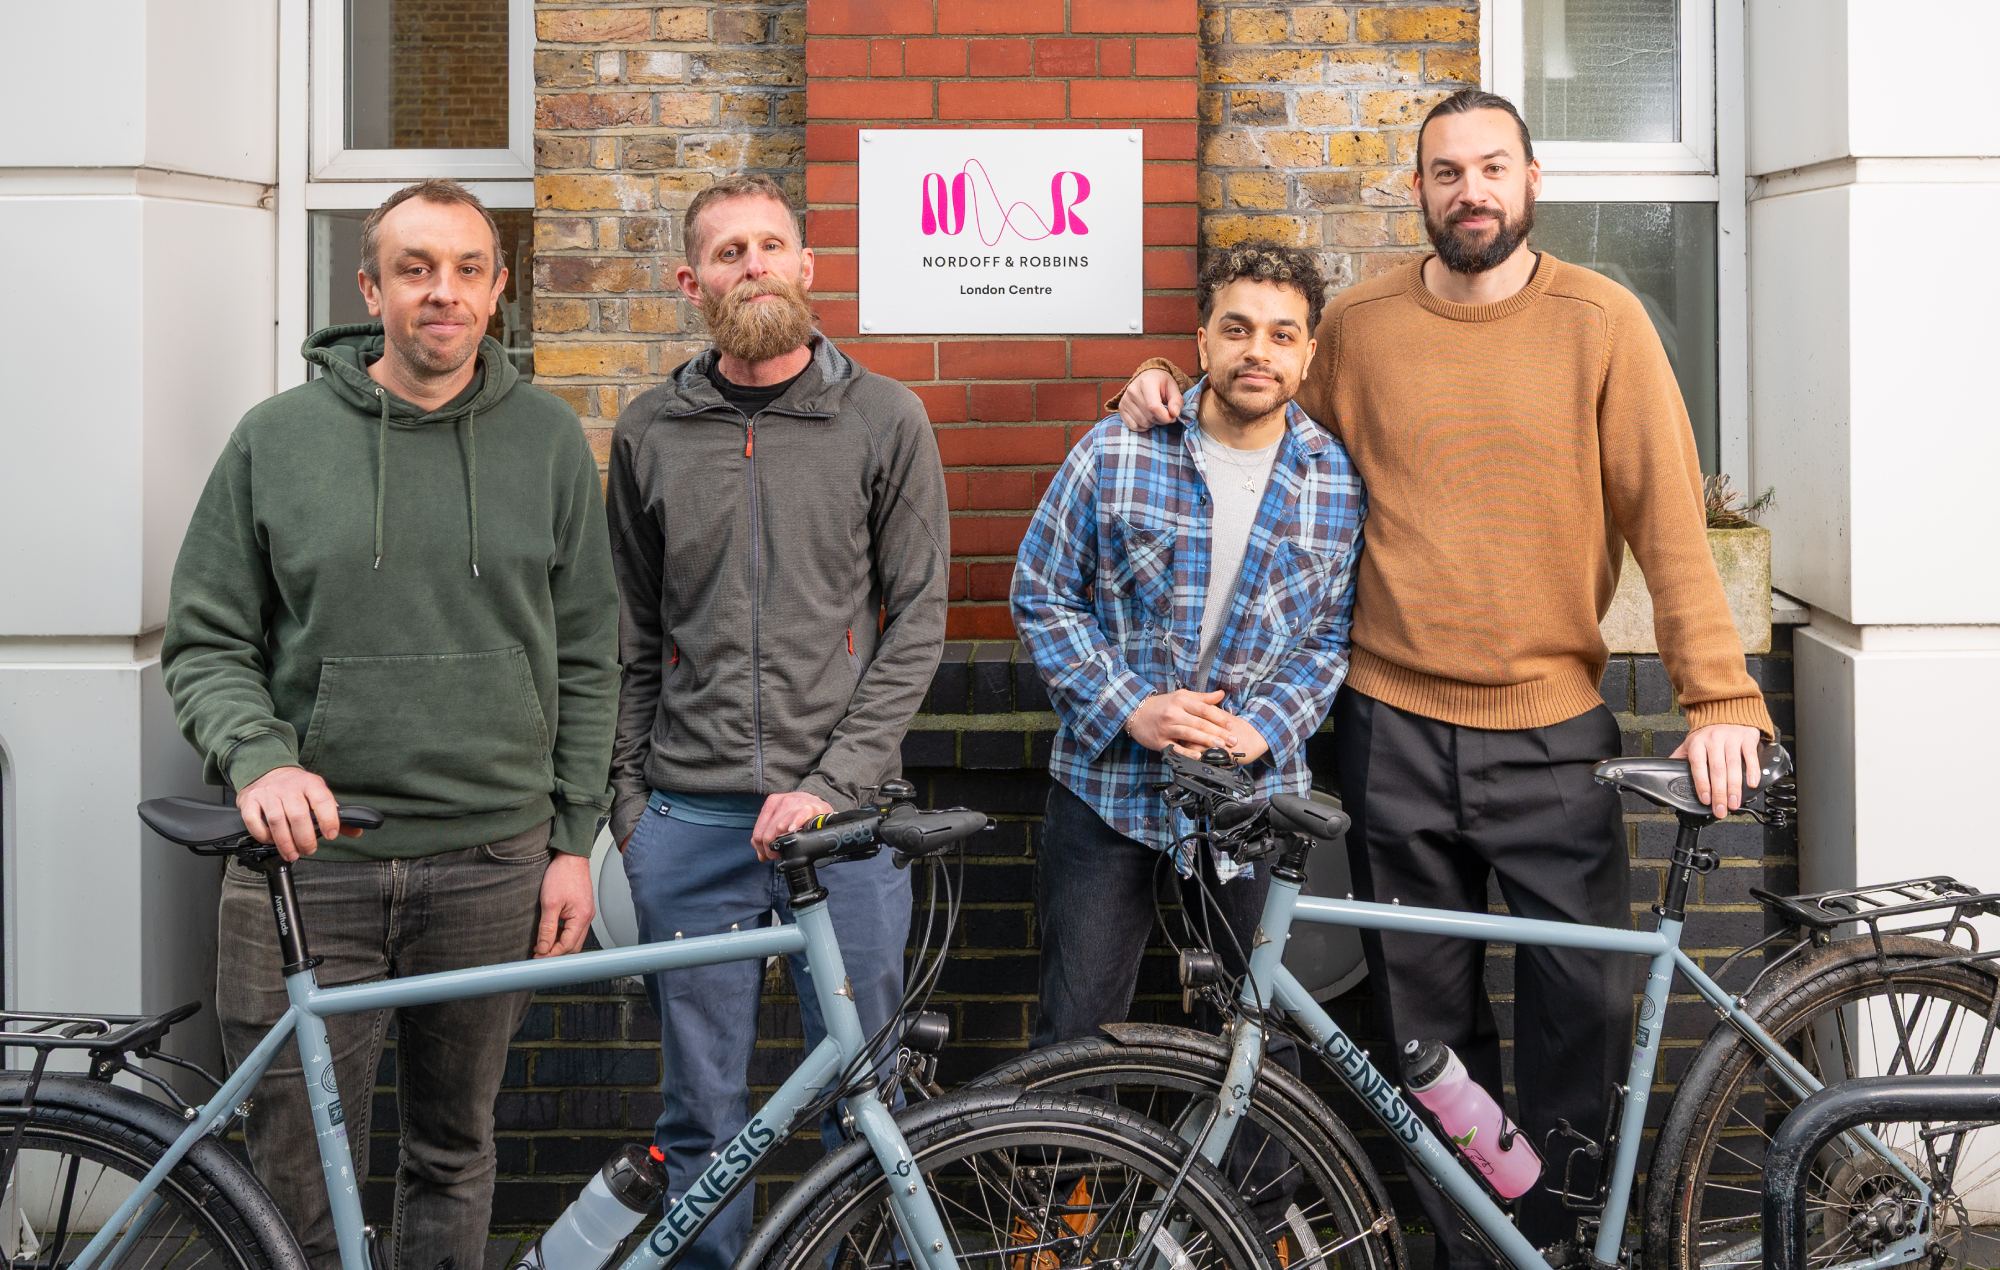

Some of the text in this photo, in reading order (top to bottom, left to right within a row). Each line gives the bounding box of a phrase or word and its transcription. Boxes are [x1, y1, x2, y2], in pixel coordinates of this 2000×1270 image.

[922, 256, 1089, 268] NORDOFF & ROBBINS
[960, 284, 1053, 295] London Centre
[274, 895, 289, 936] Amplitude
[1323, 1030, 1424, 1144] GENESIS
[649, 1118, 776, 1258] GENESIS
